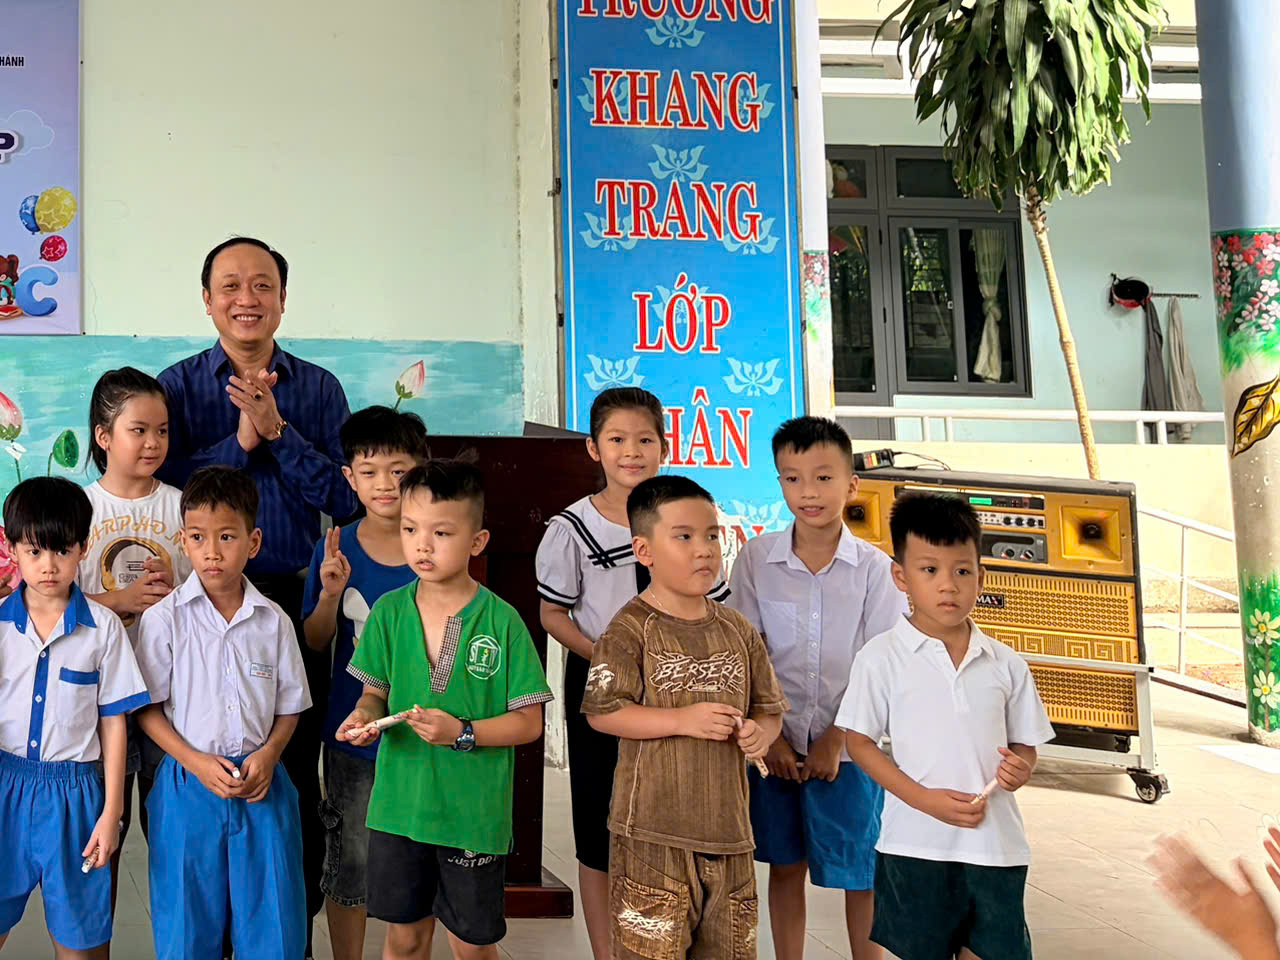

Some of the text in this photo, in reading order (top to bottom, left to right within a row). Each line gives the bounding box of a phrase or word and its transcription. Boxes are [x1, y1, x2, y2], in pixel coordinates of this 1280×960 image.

[589, 68, 762, 133] KHANG
[595, 179, 761, 242] TRANG
[632, 272, 731, 354] LỚP
[659, 387, 753, 468] HÂN
[656, 659, 742, 683] BERSERK
[447, 855, 477, 868] JUST
